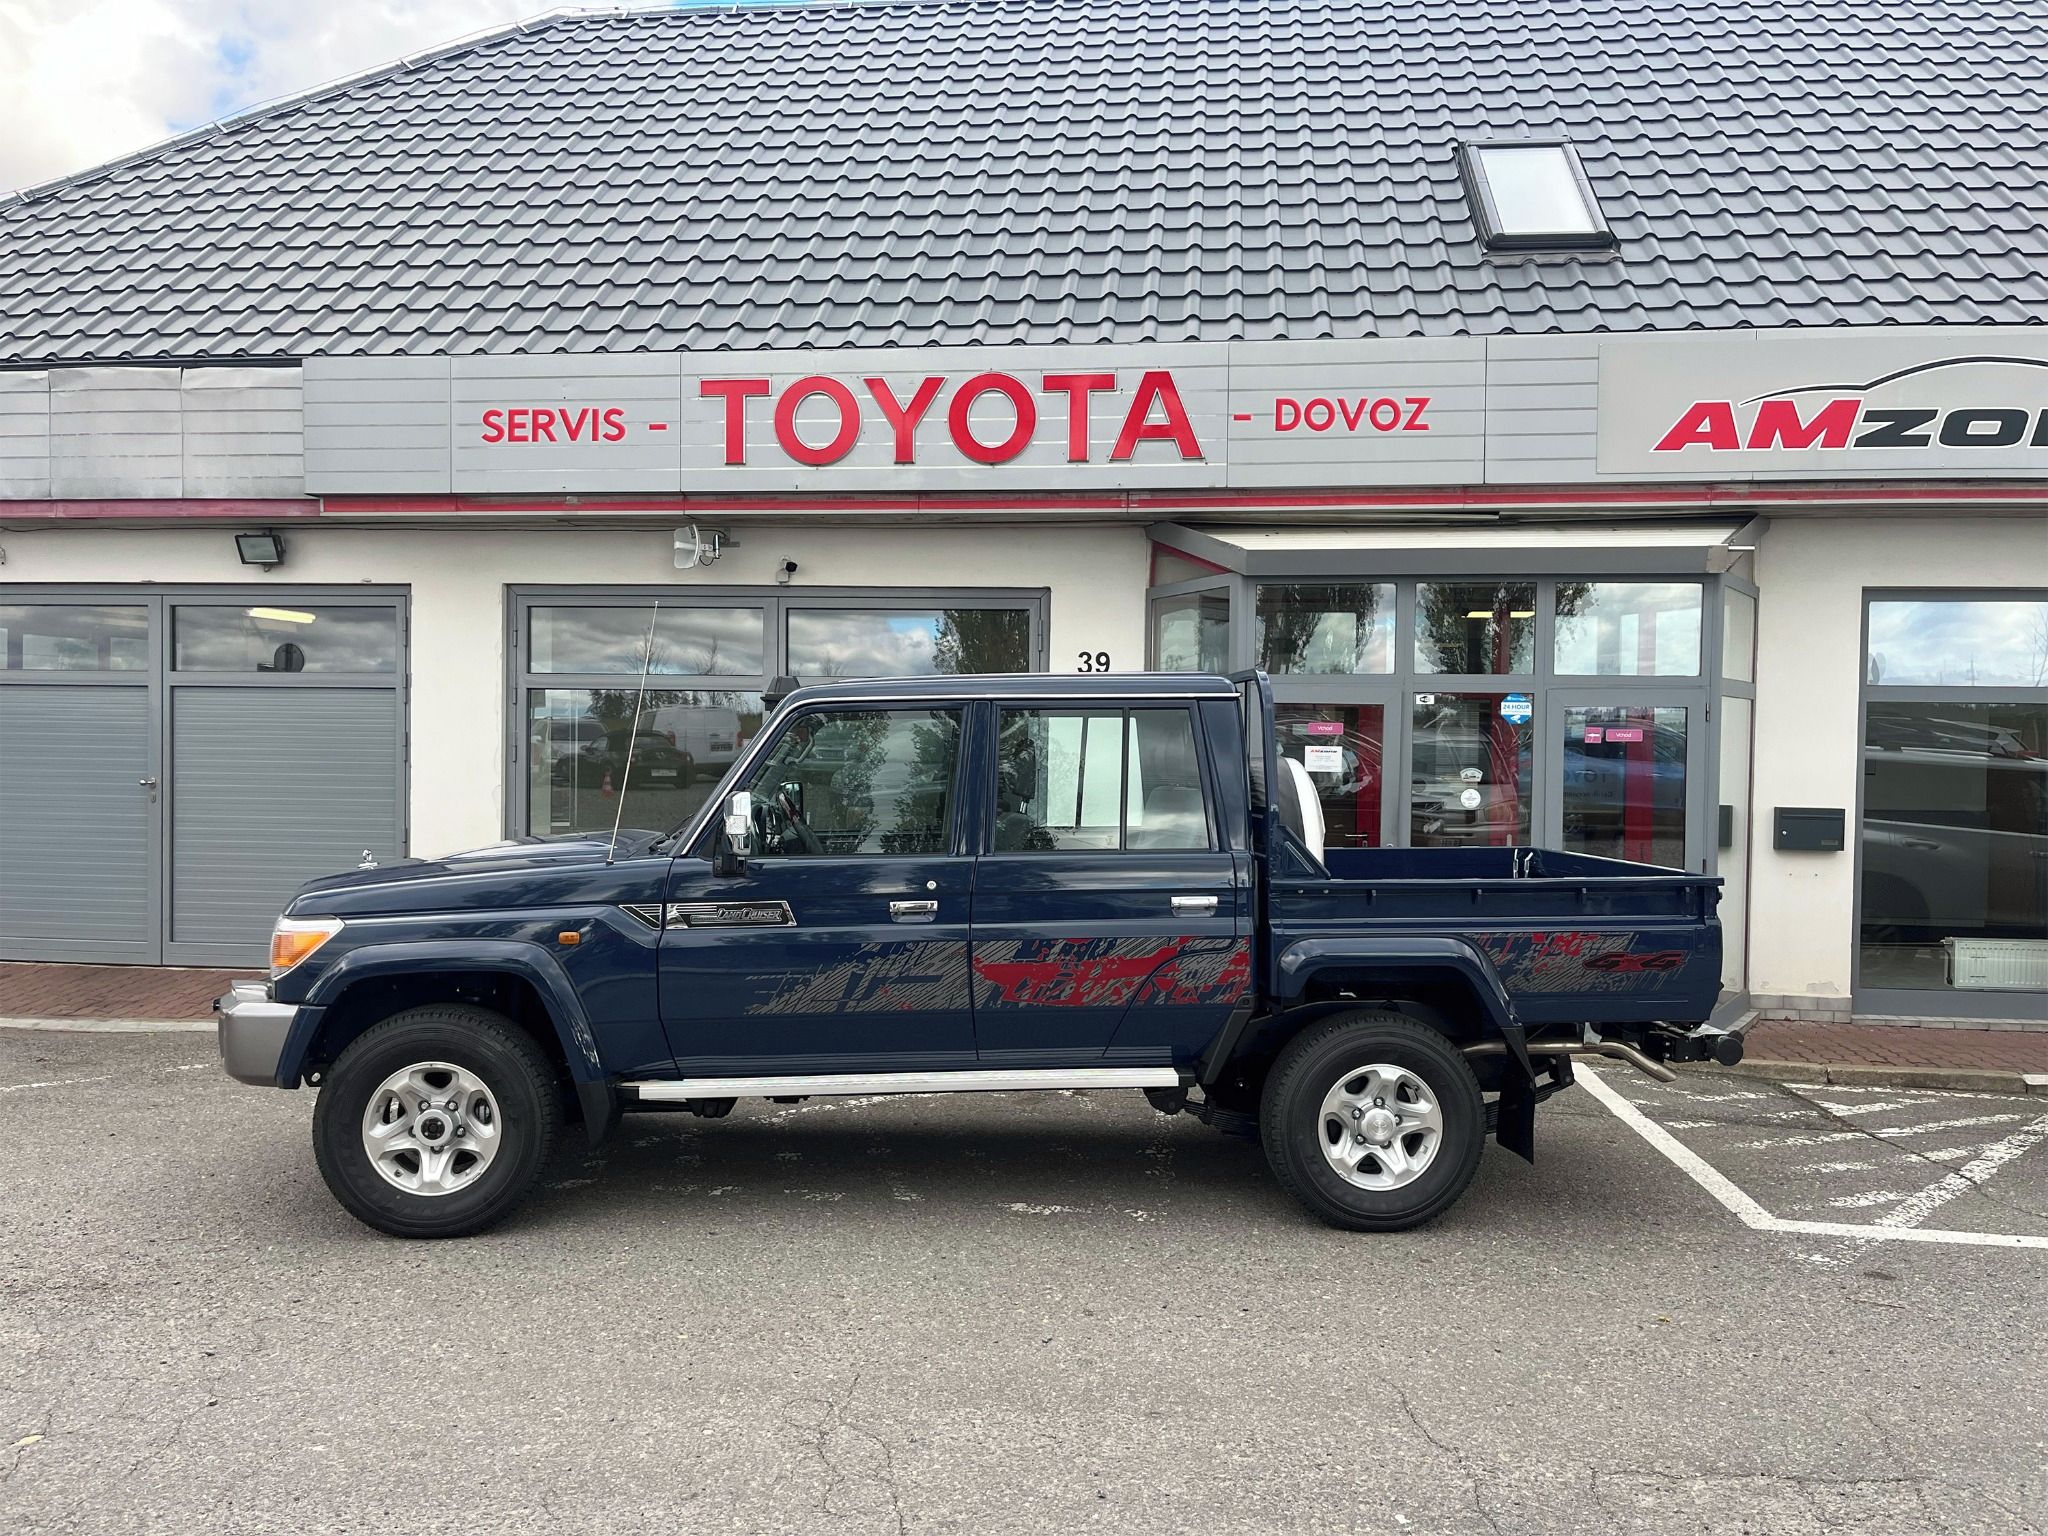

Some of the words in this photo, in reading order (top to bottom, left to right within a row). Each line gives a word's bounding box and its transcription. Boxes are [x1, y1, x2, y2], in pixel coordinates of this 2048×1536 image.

[480, 407, 627, 444] SERVIS
[700, 369, 1205, 466] TOYOTA
[1274, 397, 1431, 432] DOVOZ
[1077, 651, 1111, 672] 39
